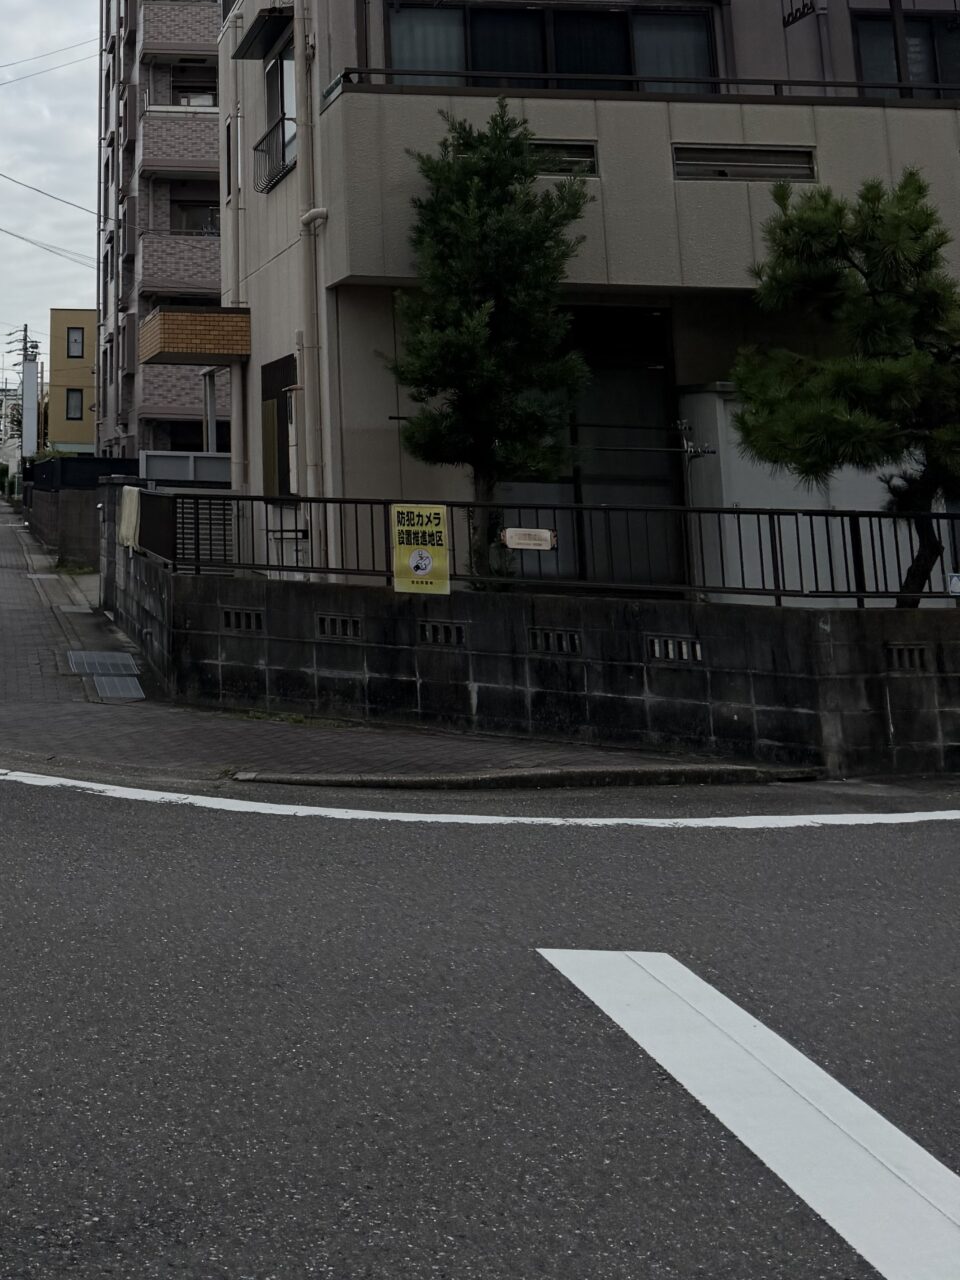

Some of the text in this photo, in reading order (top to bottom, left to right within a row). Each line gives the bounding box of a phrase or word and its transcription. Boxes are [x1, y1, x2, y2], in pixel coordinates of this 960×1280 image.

[396, 510, 441, 527] 防犯カメラ
[398, 529, 444, 547] 設置推進地区
